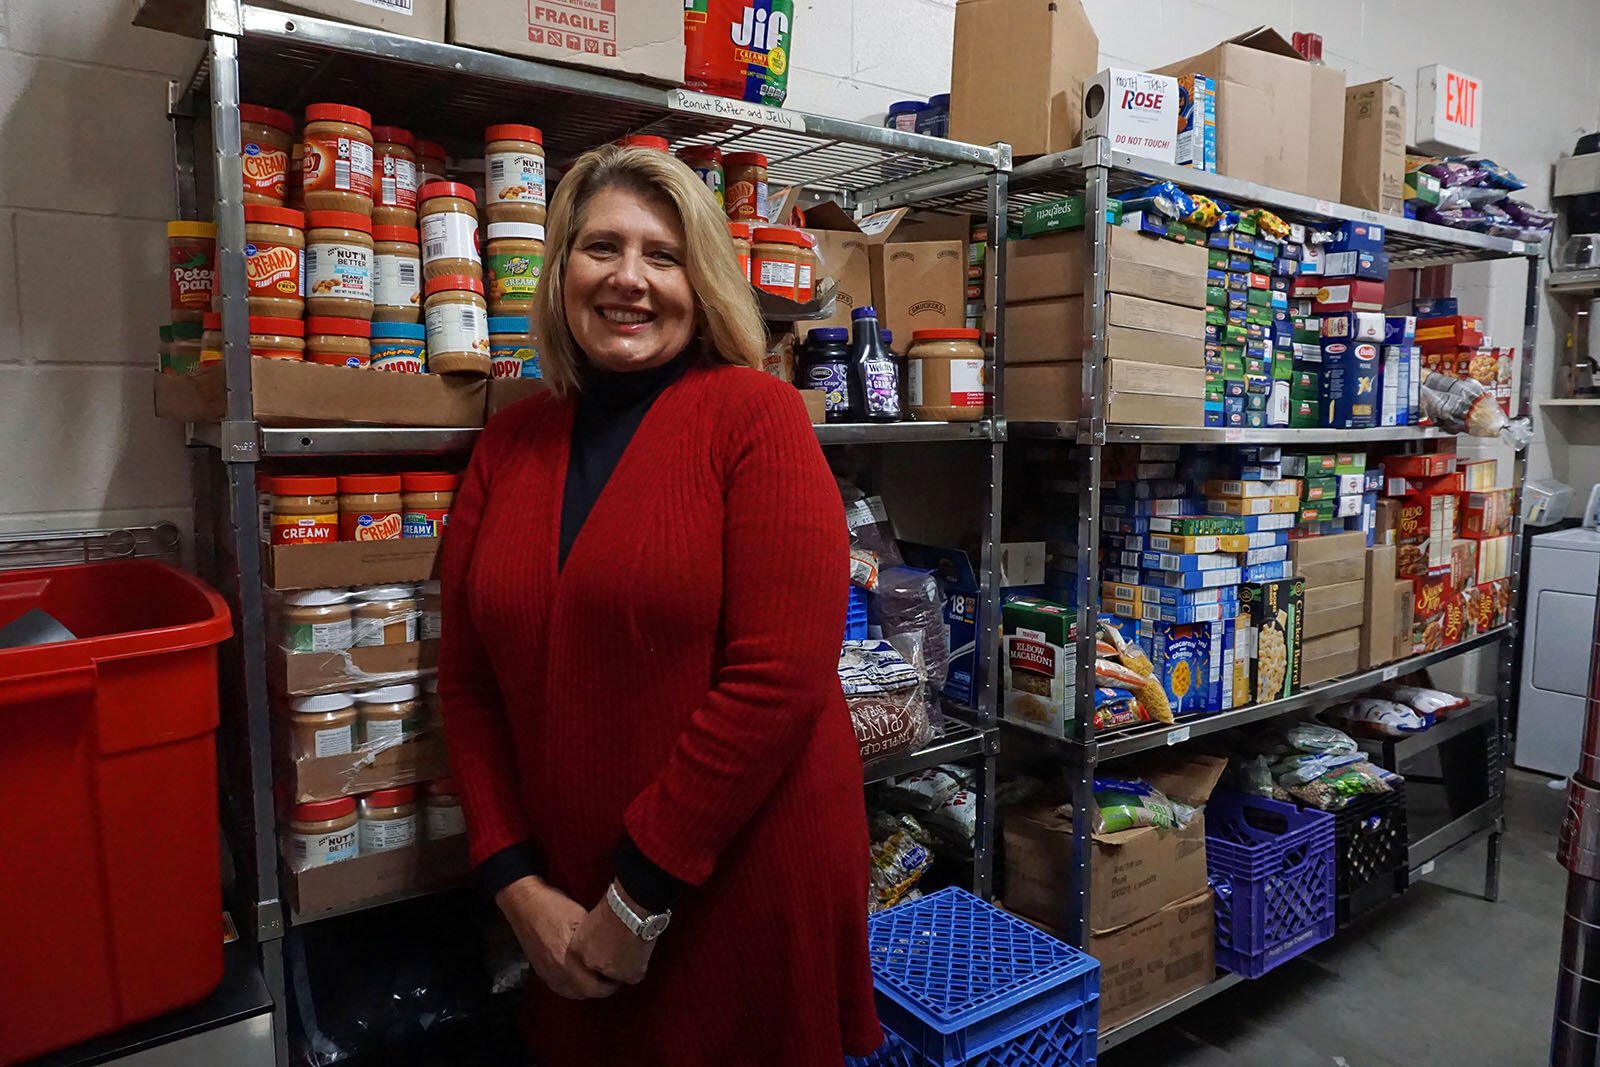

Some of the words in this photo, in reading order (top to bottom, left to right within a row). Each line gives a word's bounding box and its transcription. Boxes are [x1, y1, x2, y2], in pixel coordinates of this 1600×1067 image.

[535, 6, 609, 33] FRAGILE
[731, 6, 788, 50] Jif
[740, 49, 767, 62] CREAMY
[1116, 76, 1138, 91] MOTH
[1144, 78, 1168, 93] TRAP
[676, 89, 711, 110] Peanut
[714, 99, 744, 116] Butter
[747, 107, 762, 119] and
[766, 110, 792, 128] Jelly
[1122, 90, 1164, 110] ROSE
[1446, 73, 1478, 128] EXIT
[1116, 135, 1126, 143] DO
[1127, 135, 1143, 145] NOT
[1144, 138, 1170, 150] TOUCH!
[1037, 202, 1072, 220] spaghetti
[337, 250, 366, 260] NUT'N
[337, 258, 366, 267] BETTER
[247, 250, 293, 279] CREAMY
[282, 528, 329, 539] CREAMY
[950, 595, 964, 613] 18
[1294, 600, 1303, 646] Cracker
[1022, 631, 1040, 640] meijer
[1016, 642, 1045, 656] ELBOW
[1169, 641, 1196, 651] macaroni
[1010, 650, 1053, 668] MACARONI
[1292, 649, 1301, 685] Barrel
